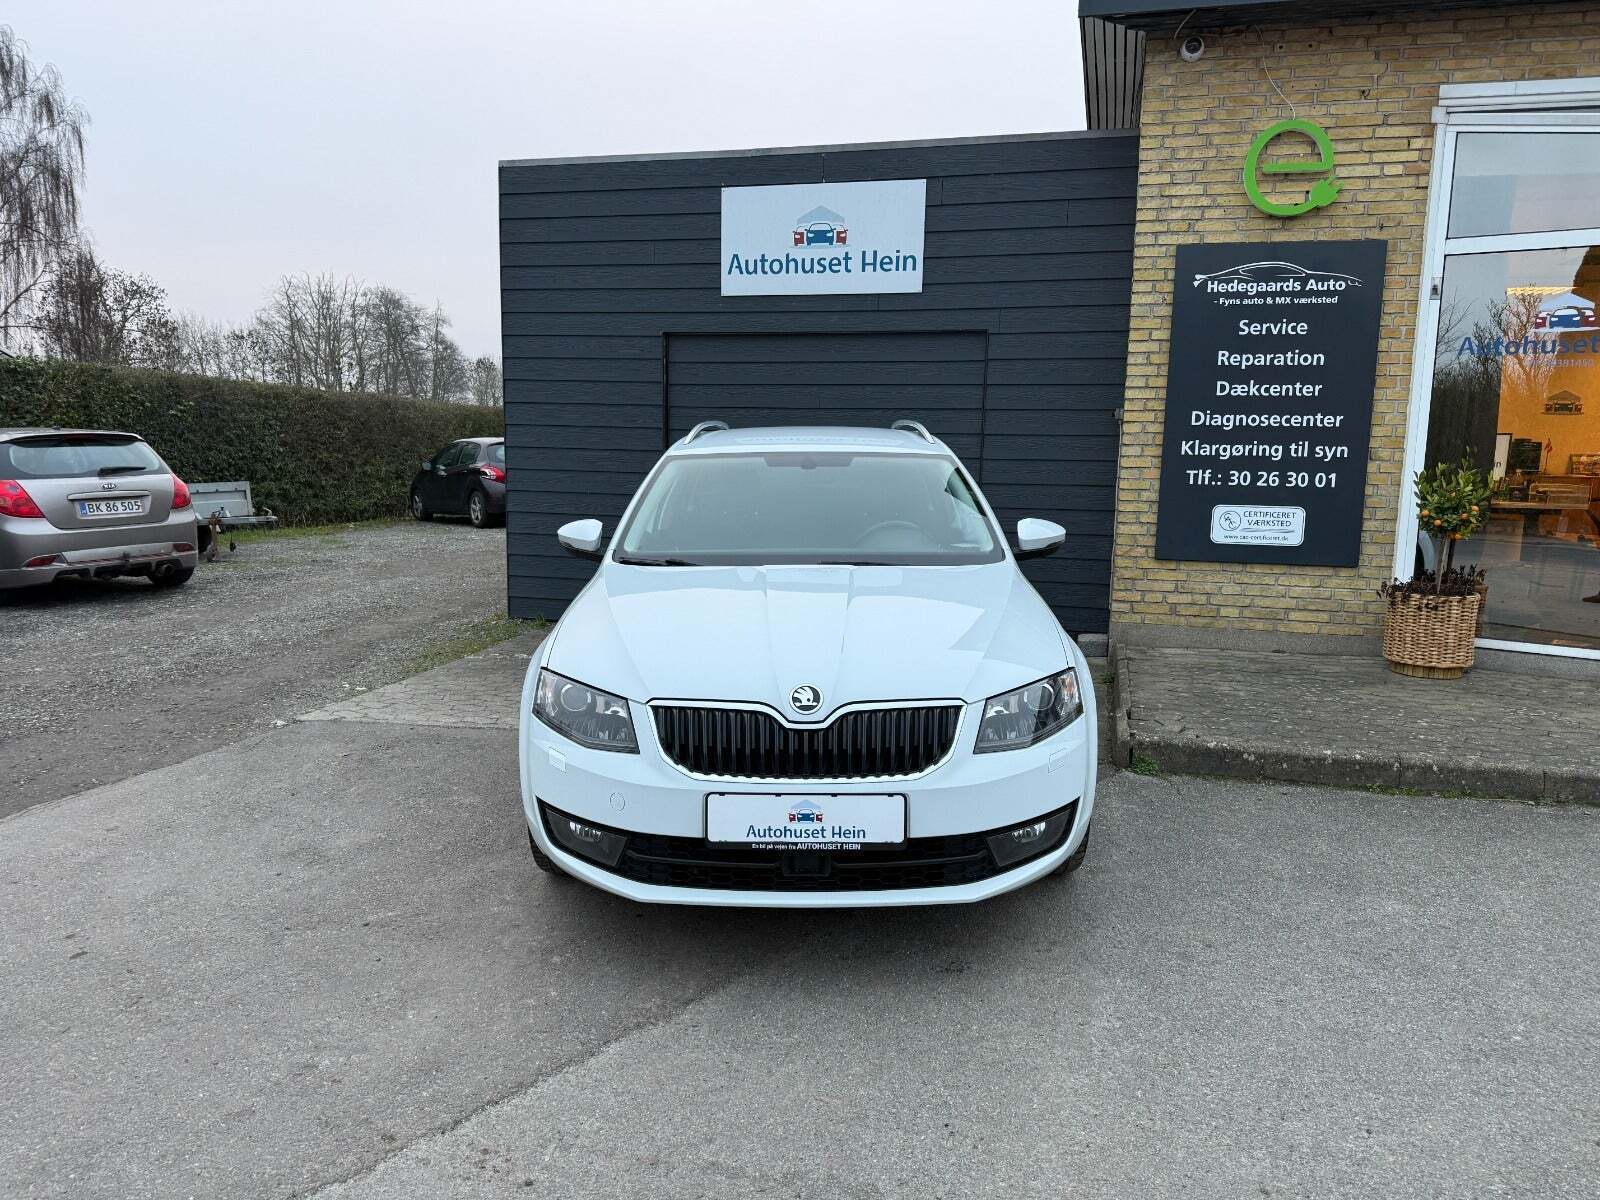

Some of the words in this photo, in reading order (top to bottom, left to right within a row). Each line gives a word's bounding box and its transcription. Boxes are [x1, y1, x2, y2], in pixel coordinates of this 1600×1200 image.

[727, 250, 852, 275] Autohuset
[861, 250, 917, 273] Hein
[1207, 278, 1301, 295] Hedegaards
[1305, 278, 1346, 291] Auto
[1219, 297, 1241, 307] Fyns
[1242, 297, 1264, 305] auto
[1266, 297, 1274, 305] &
[1276, 296, 1292, 304] MX
[1294, 296, 1339, 304] værksted
[1238, 318, 1308, 335] Service
[1217, 350, 1325, 370] Reparation
[1215, 380, 1323, 397] Dækcenter
[1191, 410, 1344, 430] Diagnosecenter
[1181, 440, 1283, 461] Klargøring
[1289, 441, 1309, 458] til
[1314, 445, 1349, 462] syn
[1186, 469, 1222, 486] Tlf.:
[1228, 470, 1251, 486] 30
[1256, 471, 1280, 486] 26
[1285, 471, 1309, 487] 30
[1314, 472, 1337, 488] 01
[87, 502, 103, 513] BK
[105, 502, 119, 512] 86
[120, 501, 141, 511] 505
[1243, 510, 1297, 519] CERTIFICERET
[746, 825, 827, 839] Autohuset
[831, 825, 866, 839] Hein
